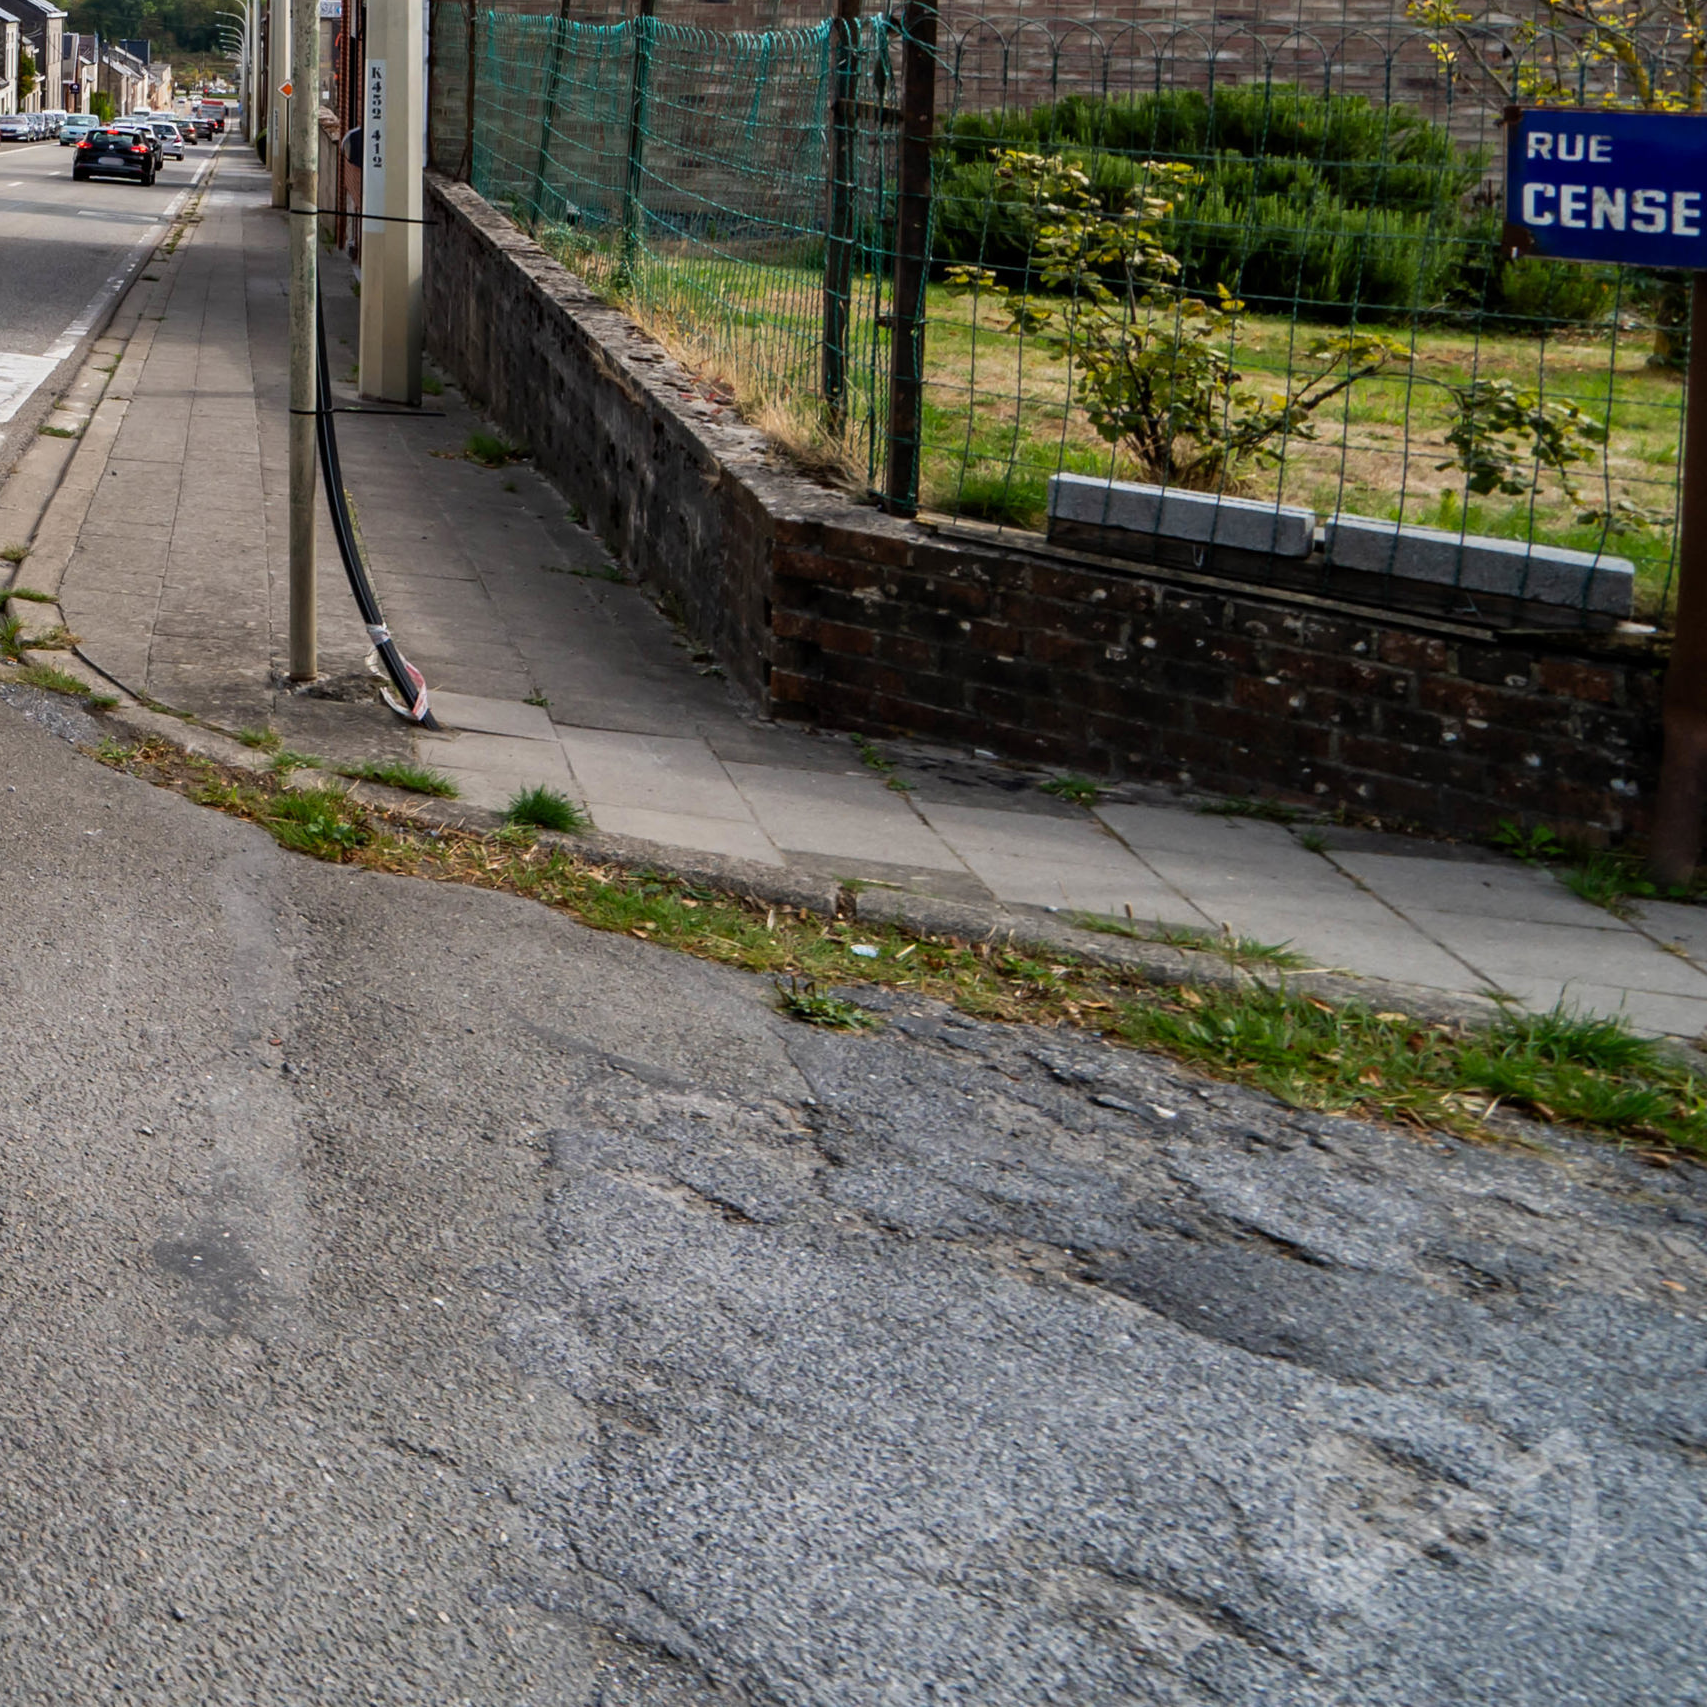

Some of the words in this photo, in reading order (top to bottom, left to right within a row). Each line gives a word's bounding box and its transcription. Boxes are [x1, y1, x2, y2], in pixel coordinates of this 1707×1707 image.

[371, 129, 382, 168] 412
[1526, 131, 1613, 163] RUE
[1522, 181, 1702, 237] CENSE
